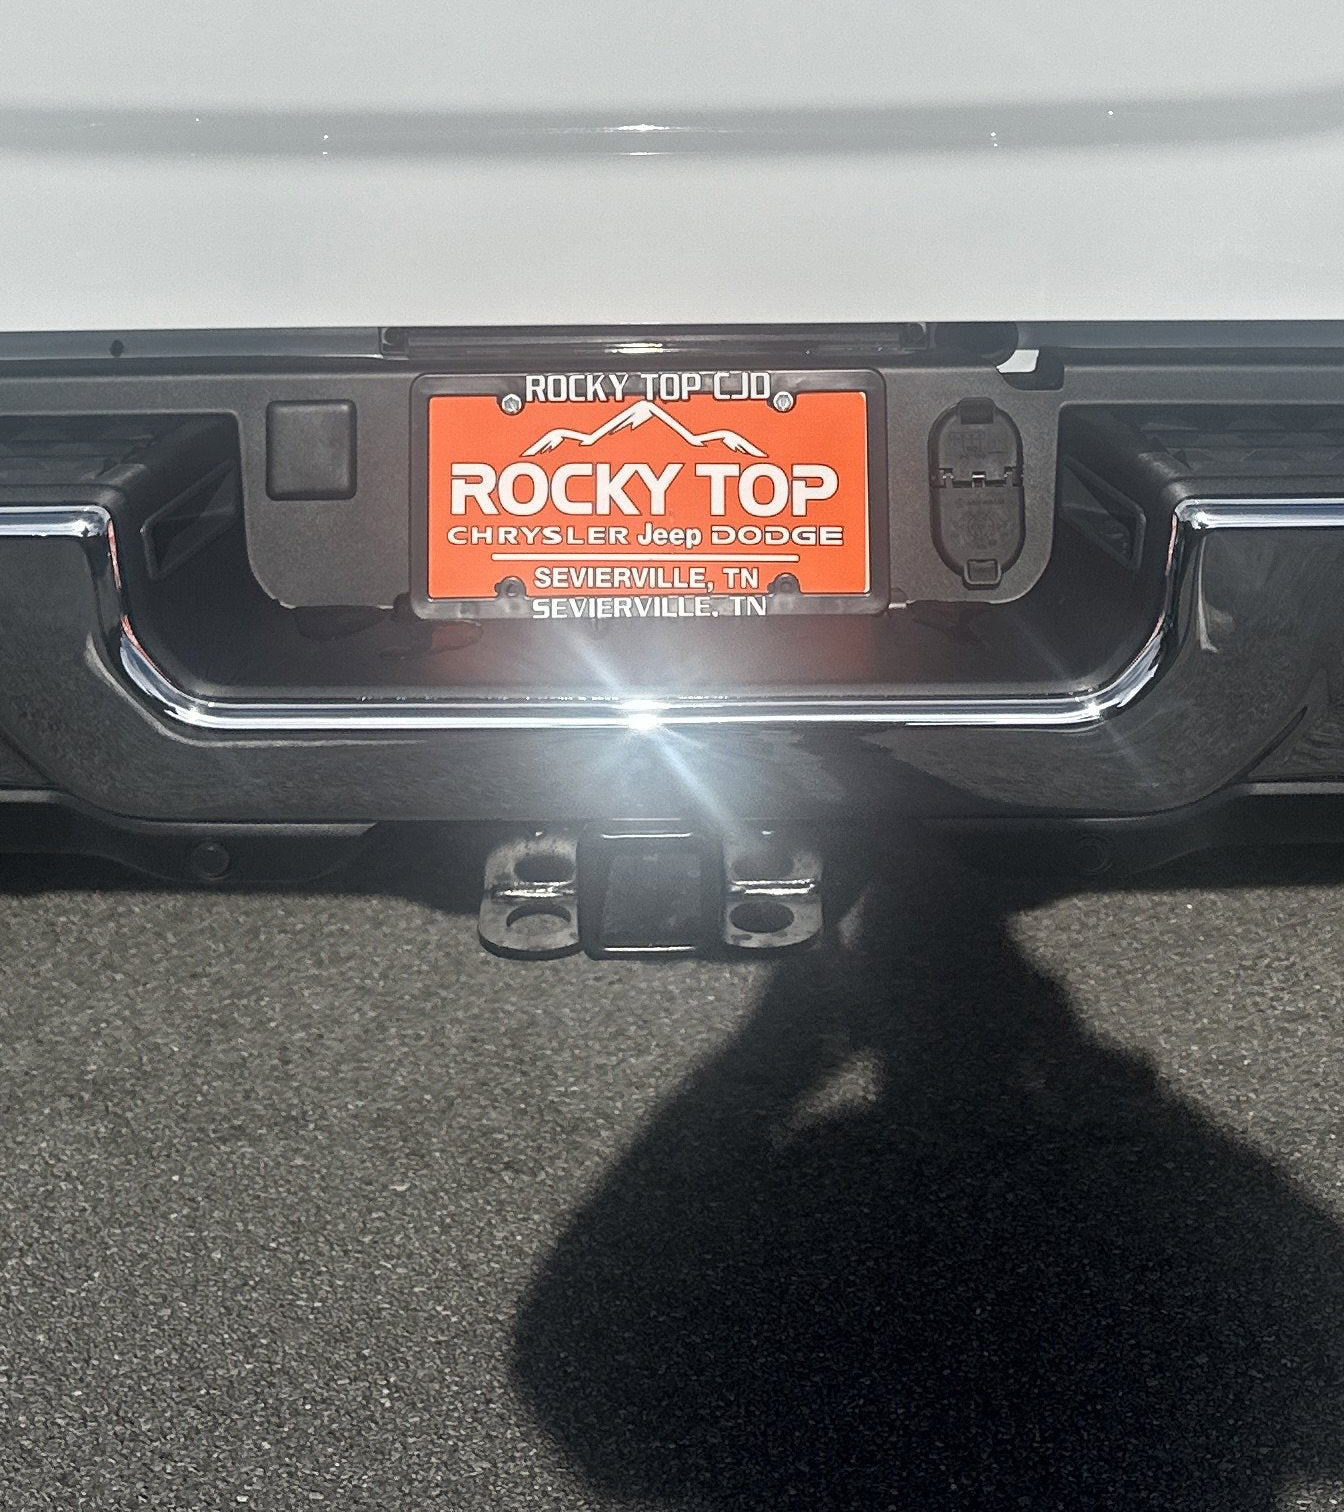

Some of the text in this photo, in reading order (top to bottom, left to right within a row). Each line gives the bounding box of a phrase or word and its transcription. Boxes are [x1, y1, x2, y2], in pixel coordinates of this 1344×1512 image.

[525, 371, 771, 403] ROCKY TOP CJD
[450, 462, 839, 517] ROCKY TOP
[447, 522, 843, 549] CHRYSLER Jeep DODGE
[533, 566, 759, 592] SEVIERVILLE, TN
[732, 595, 767, 617] TN
